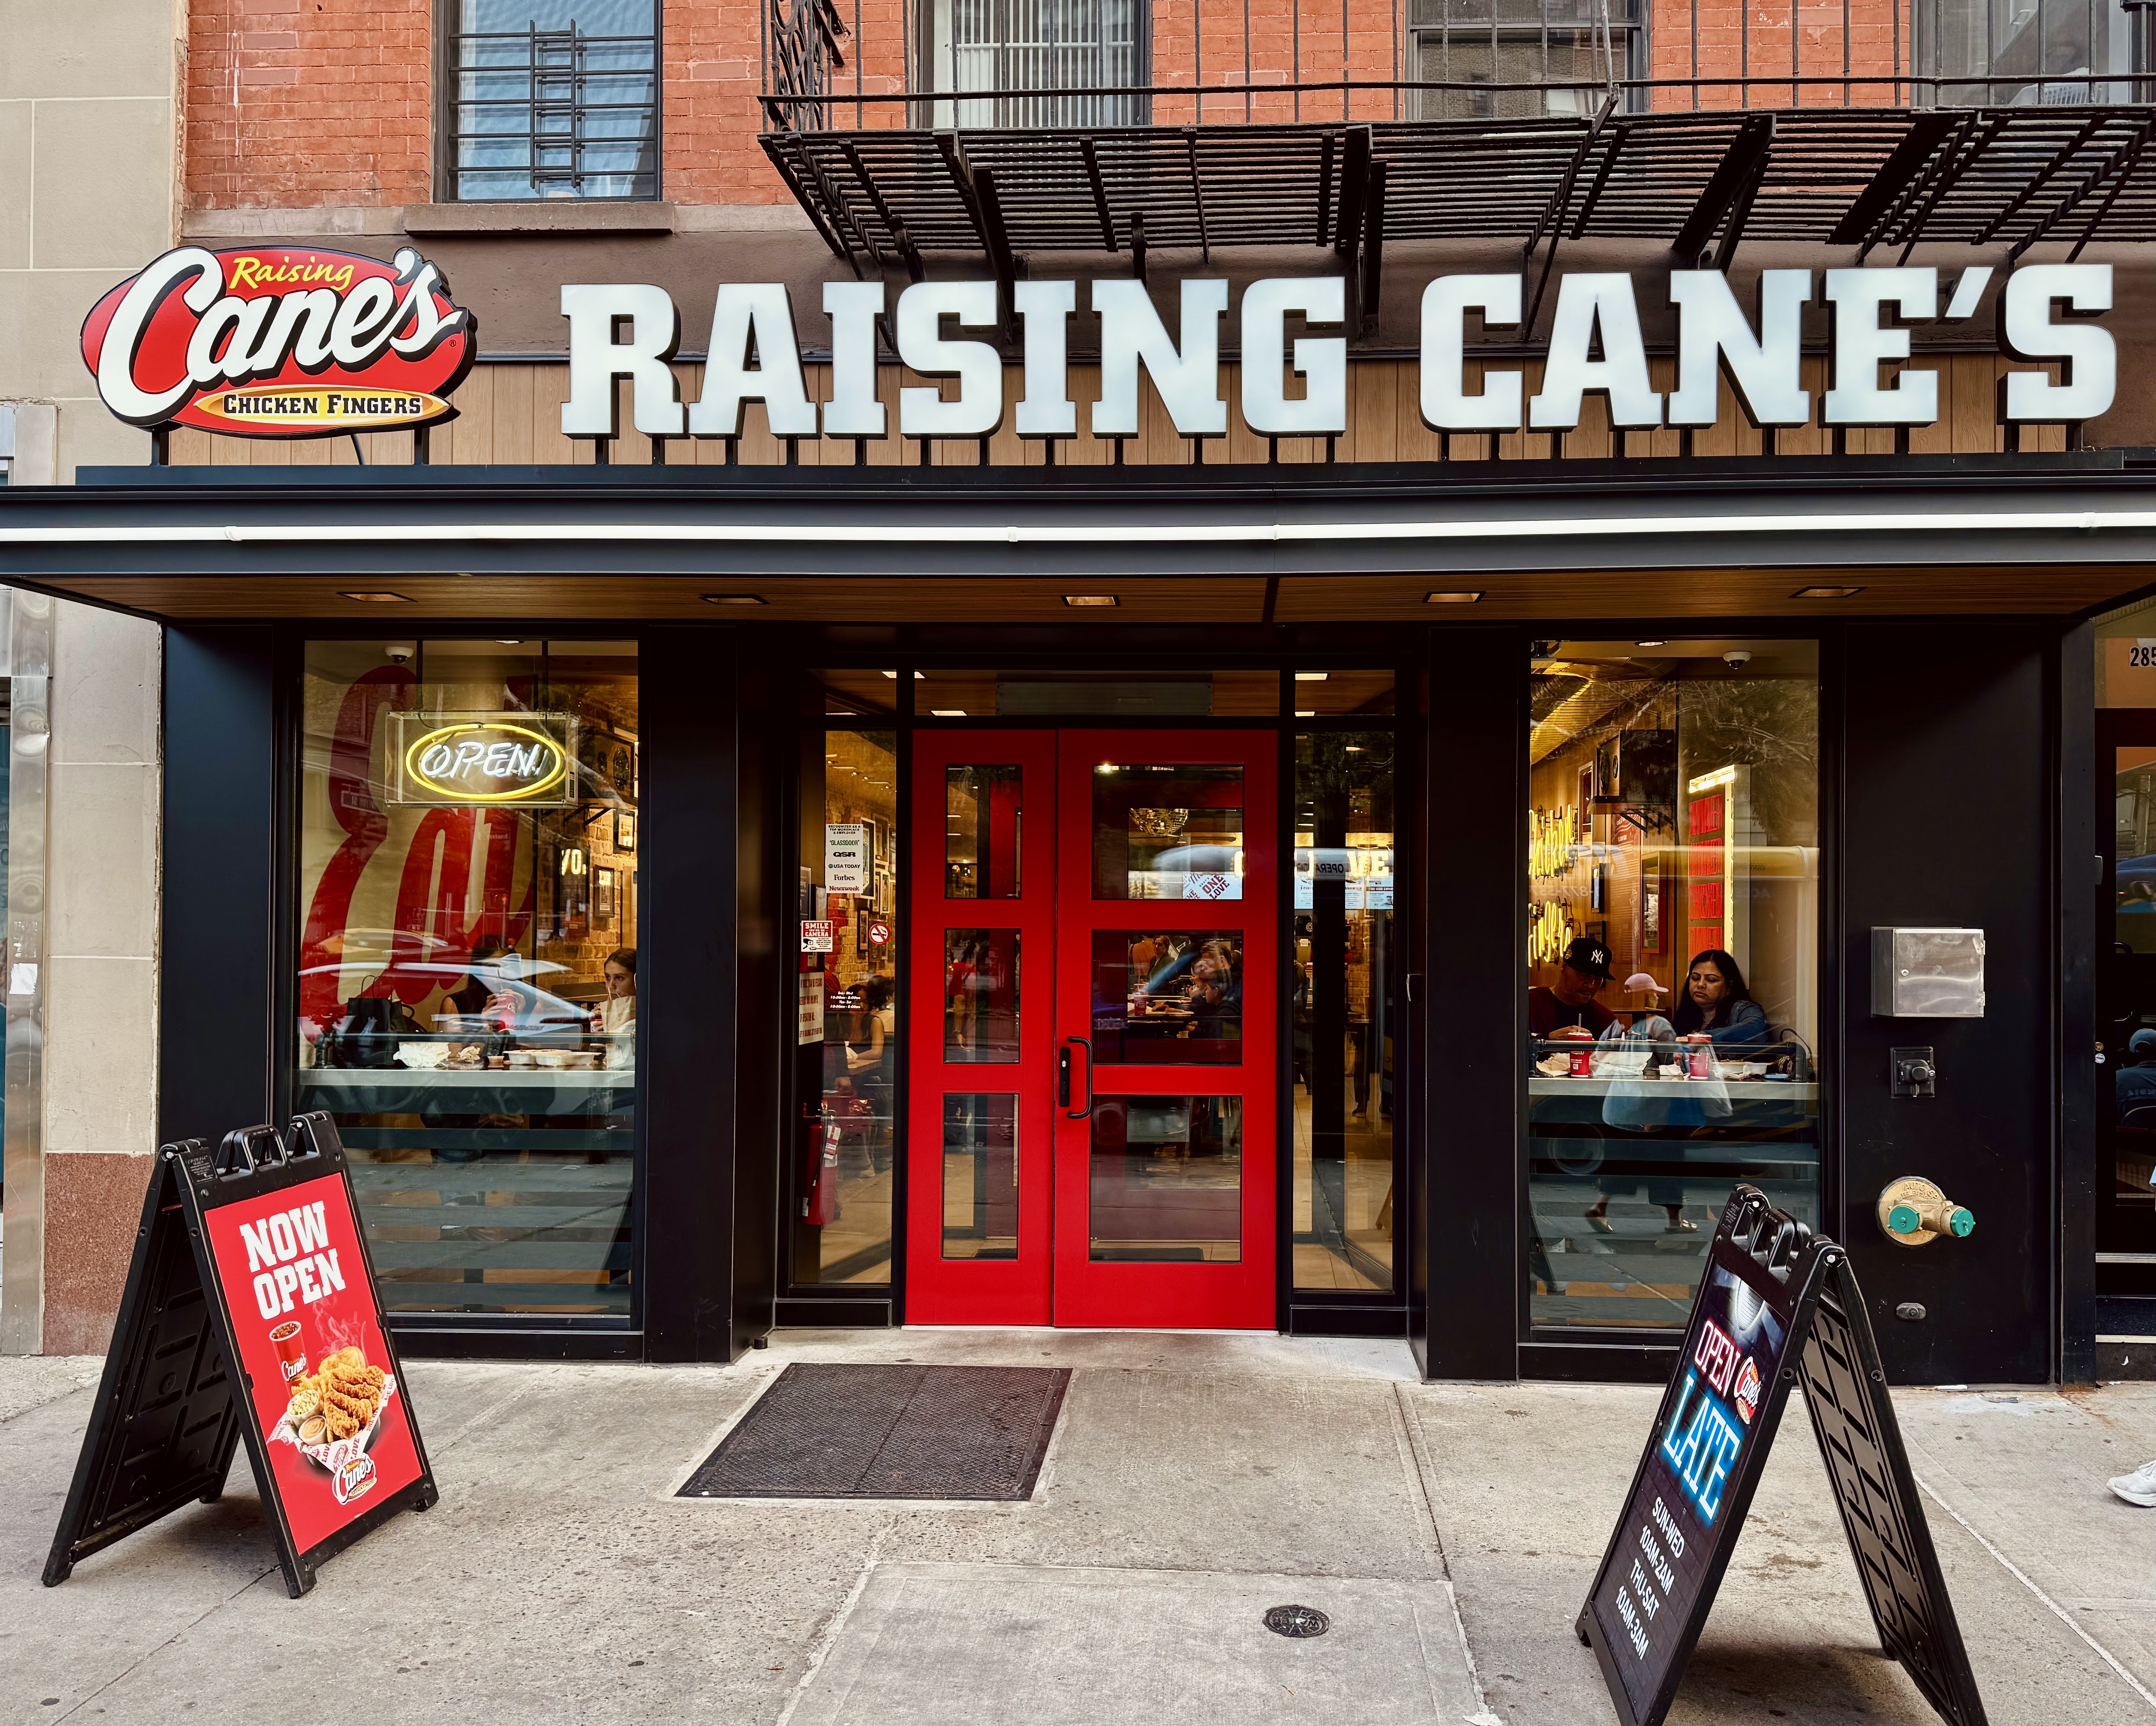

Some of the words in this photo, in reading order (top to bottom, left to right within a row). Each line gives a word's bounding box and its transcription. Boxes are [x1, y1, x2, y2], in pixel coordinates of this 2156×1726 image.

[229, 256, 355, 292] Raising
[98, 248, 463, 418] Cane's
[561, 277, 1347, 439] RAISING
[1420, 264, 2117, 432] CANE'S
[223, 393, 318, 415] CHICKEN
[327, 394, 421, 415] FINGERS
[420, 741, 540, 778] OPEN
[239, 1200, 329, 1273] NOW
[253, 1248, 346, 1320] OPEN
[281, 1352, 306, 1382] Cane's
[1695, 1320, 1741, 1397] OPEN
[1734, 1356, 1761, 1407] Cane's
[336, 1452, 373, 1503] Cane's
[1663, 1374, 1740, 1520] LATE
[1640, 1525, 1675, 1596] 10AM-2AM
[1653, 1497, 1684, 1558] SUN-WED
[1616, 1585, 1649, 1660] 10AM-3AM
[1630, 1558, 1660, 1621] THU-SAT
